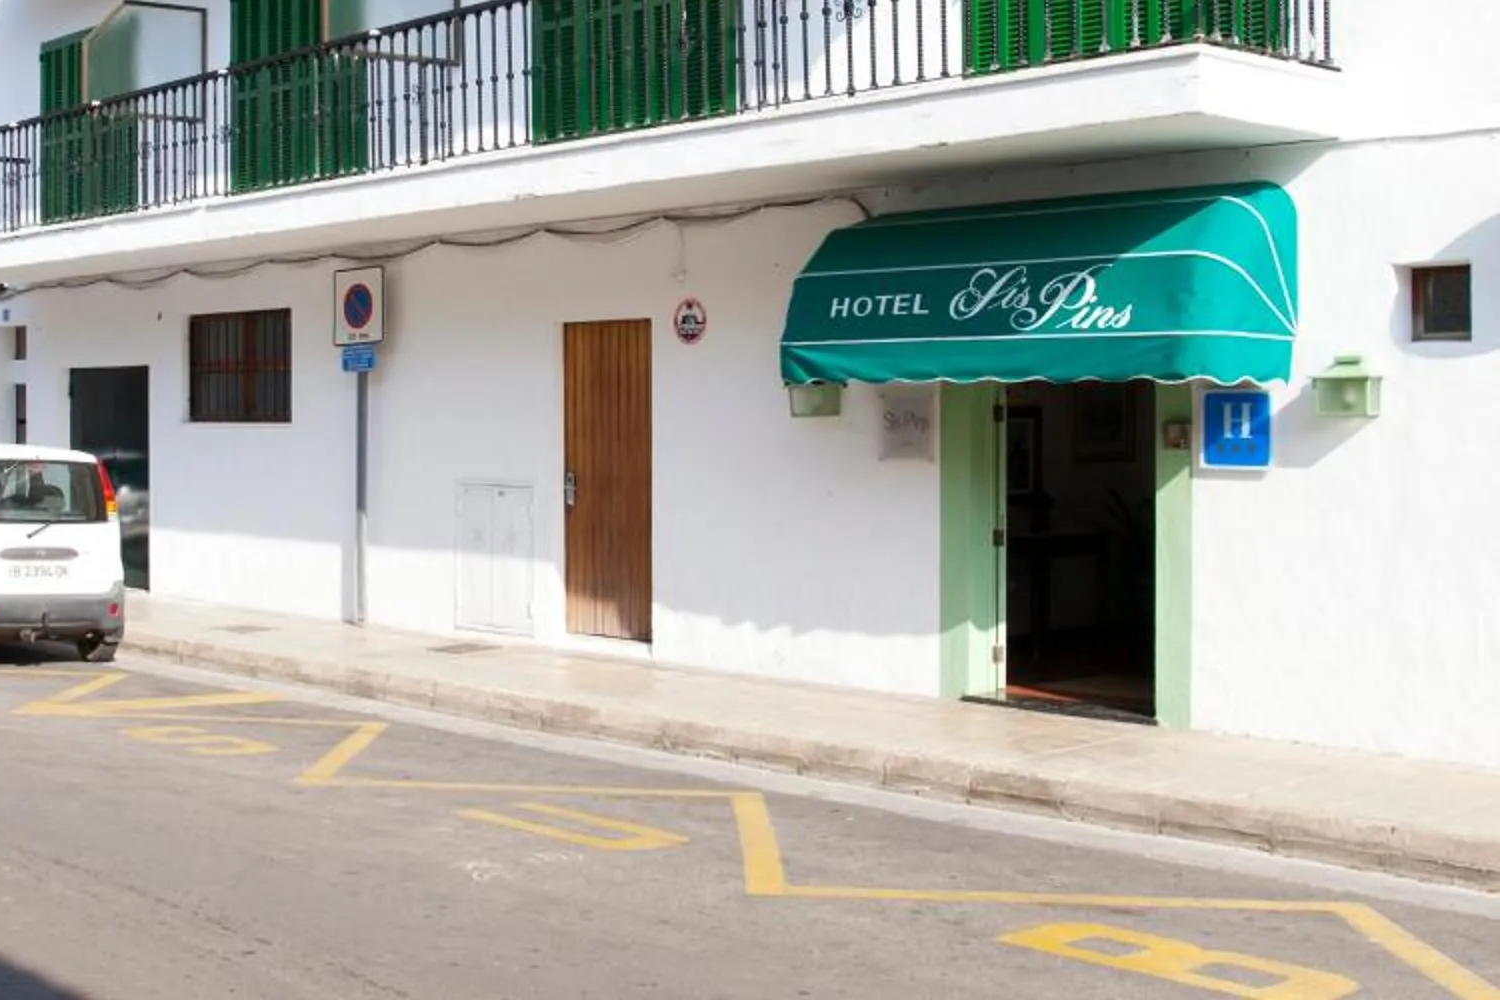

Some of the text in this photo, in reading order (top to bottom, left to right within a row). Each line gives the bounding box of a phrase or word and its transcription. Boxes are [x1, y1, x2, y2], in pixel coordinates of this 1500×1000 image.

[829, 263, 1134, 332] HOTEL Sis Pins
[1220, 401, 1253, 439] H
